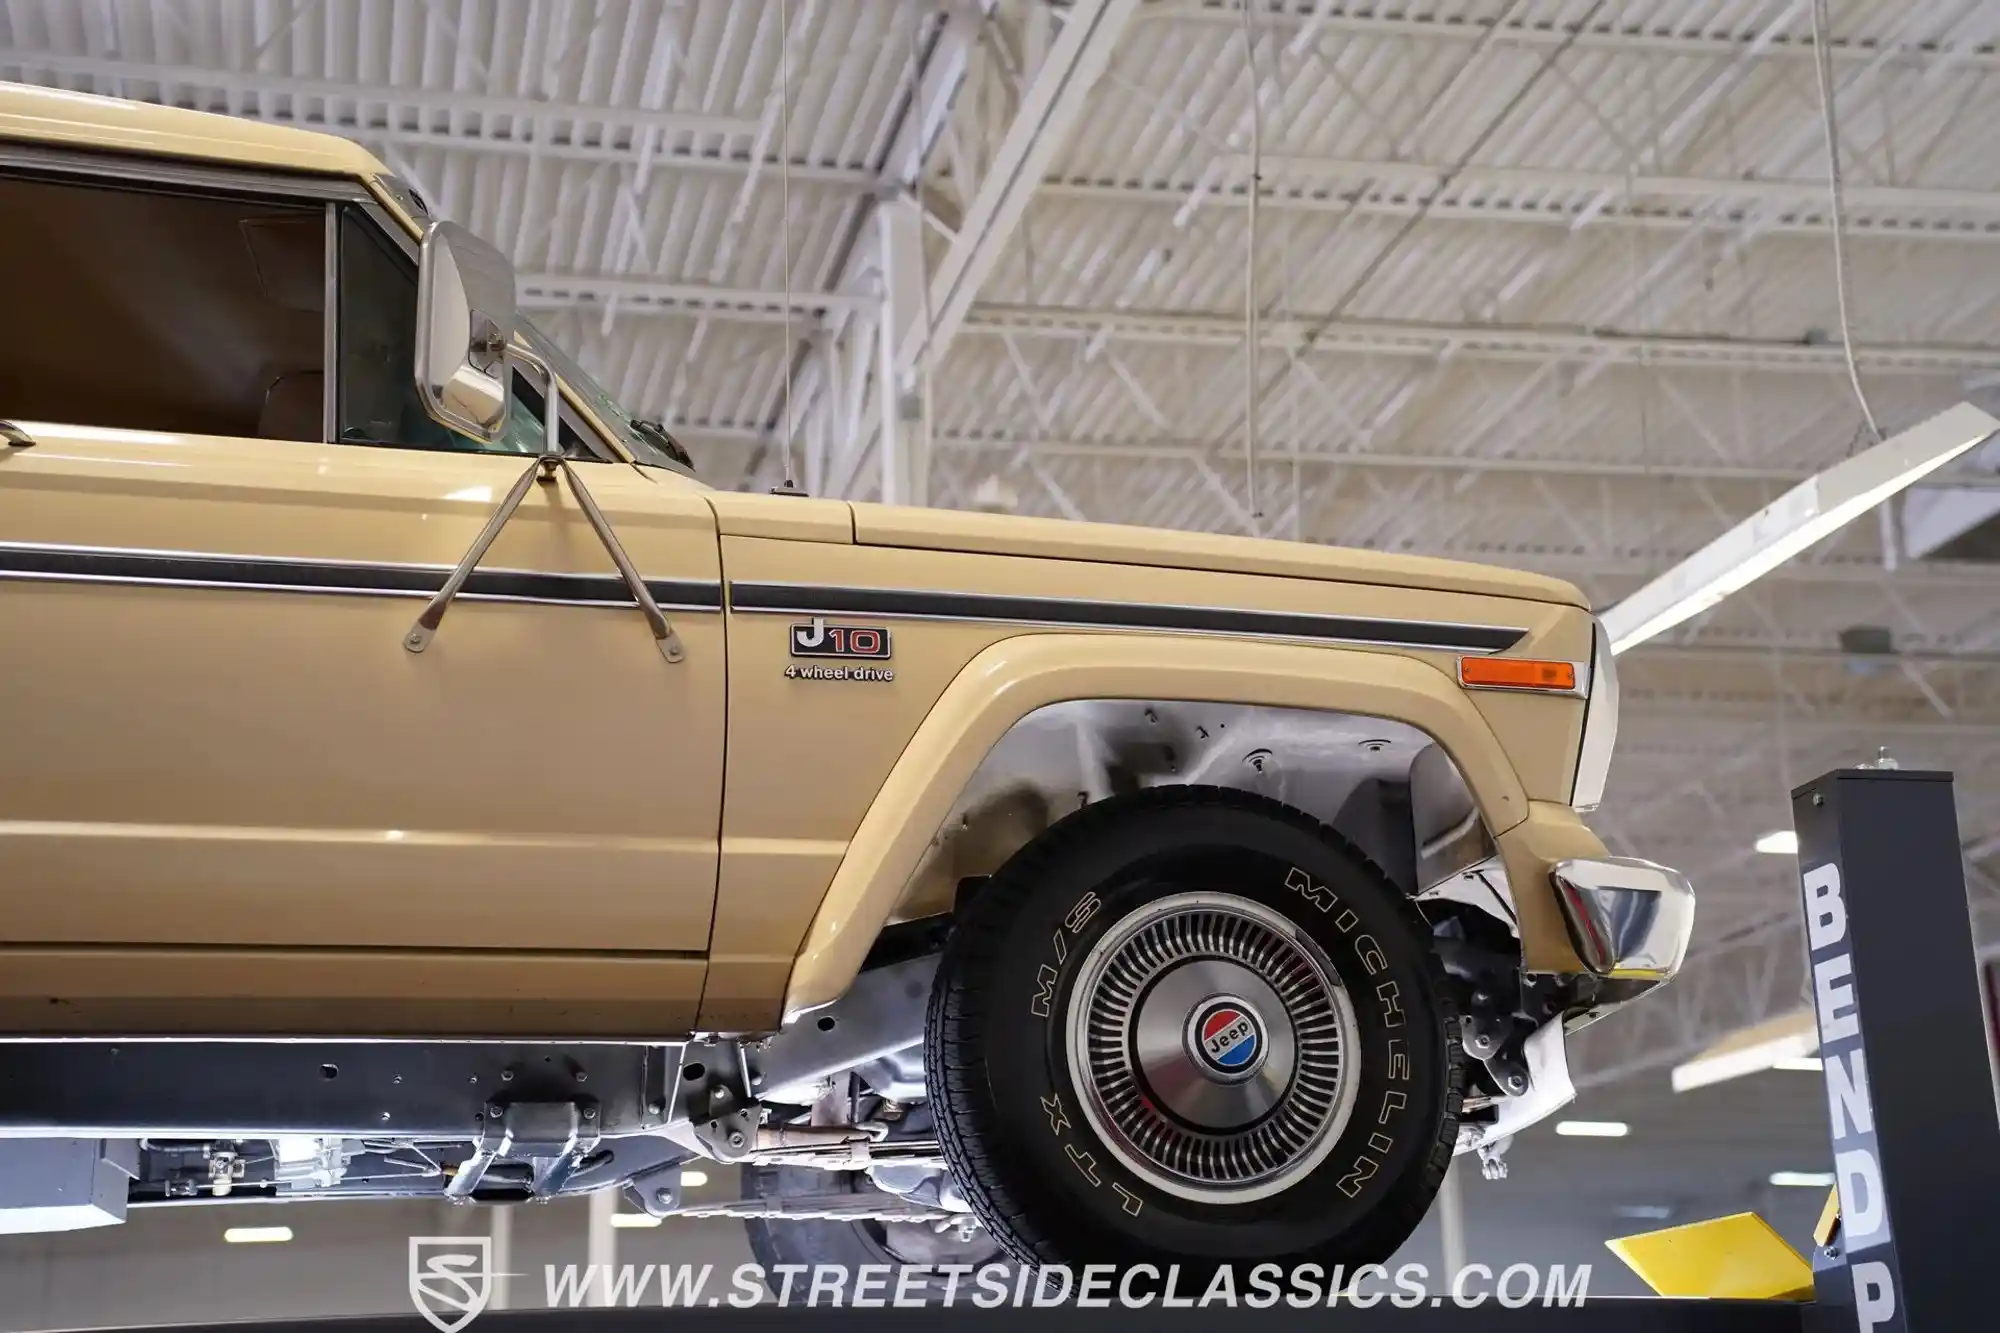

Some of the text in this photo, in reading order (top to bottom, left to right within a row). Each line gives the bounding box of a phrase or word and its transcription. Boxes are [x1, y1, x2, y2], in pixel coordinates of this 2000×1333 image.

[785, 664, 893, 681] 4 wheel drive
[796, 618, 881, 653] J10
[1030, 890, 1145, 1217] LTX M/S
[1210, 1021, 1249, 1053] Jeep
[1284, 866, 1410, 1198] MICHELIN
[1803, 862, 1896, 1333] BENDP
